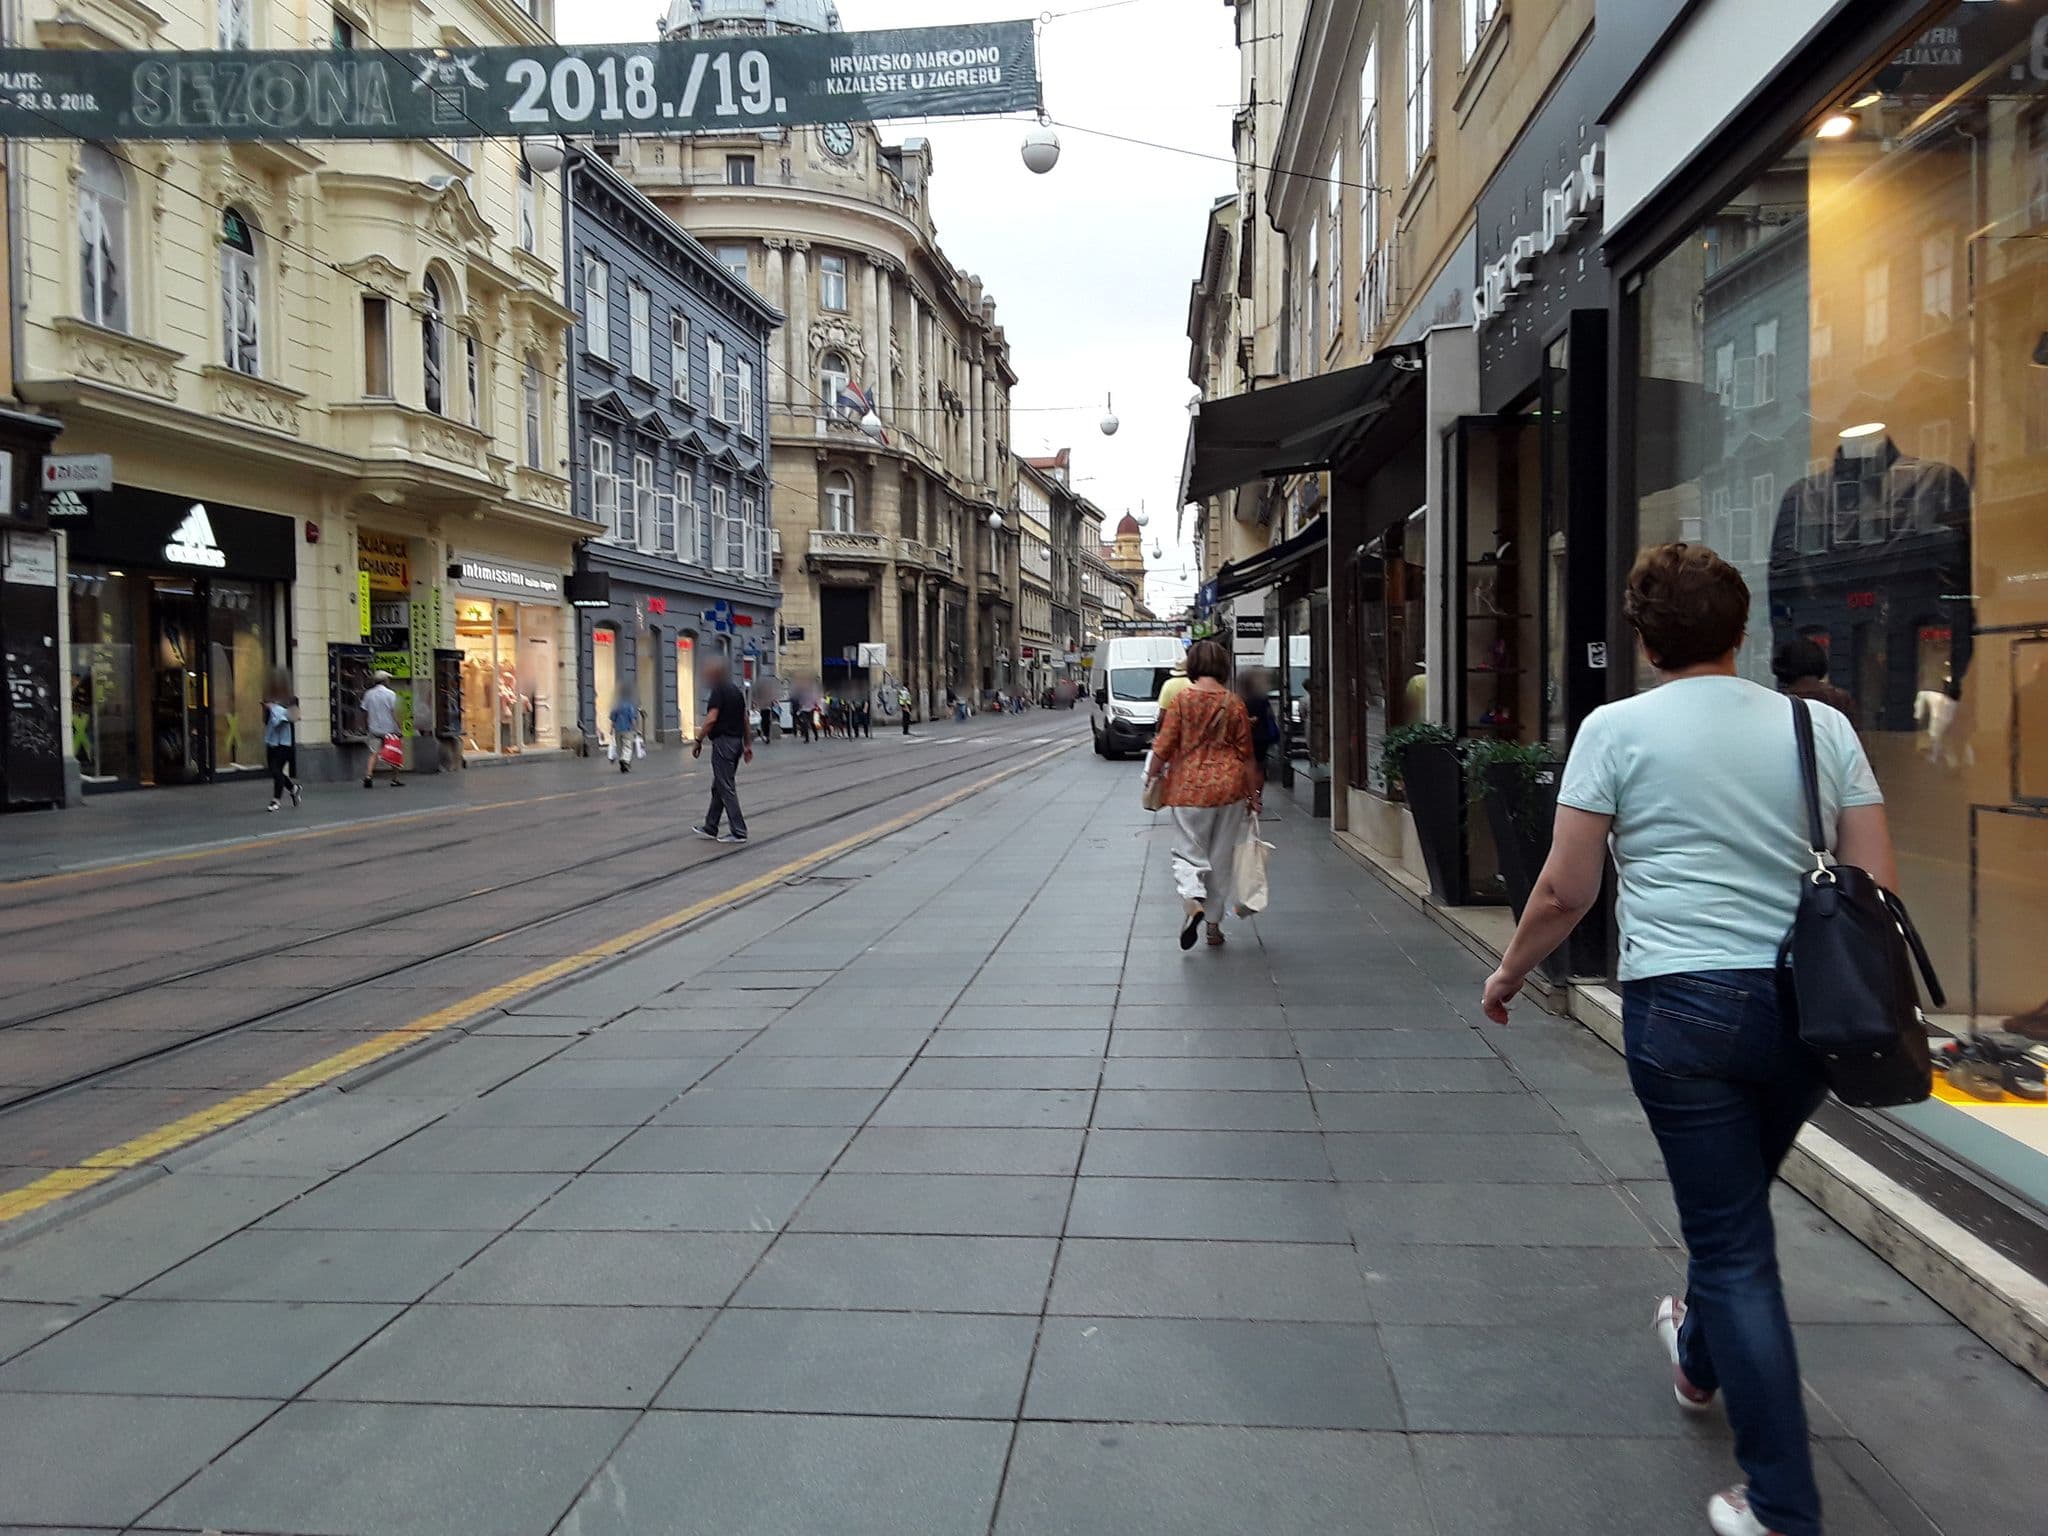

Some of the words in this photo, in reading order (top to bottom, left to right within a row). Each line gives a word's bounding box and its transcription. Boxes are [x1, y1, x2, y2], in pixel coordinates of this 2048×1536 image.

[826, 70, 907, 95] KAZALIŠTE
[911, 73, 925, 89] U
[928, 66, 1001, 88] ZAGREBU
[830, 52, 911, 74] HRVATSKO
[916, 46, 1000, 69] NARODNO
[132, 60, 397, 128] SEZONA
[505, 50, 787, 122] 2018./19.
